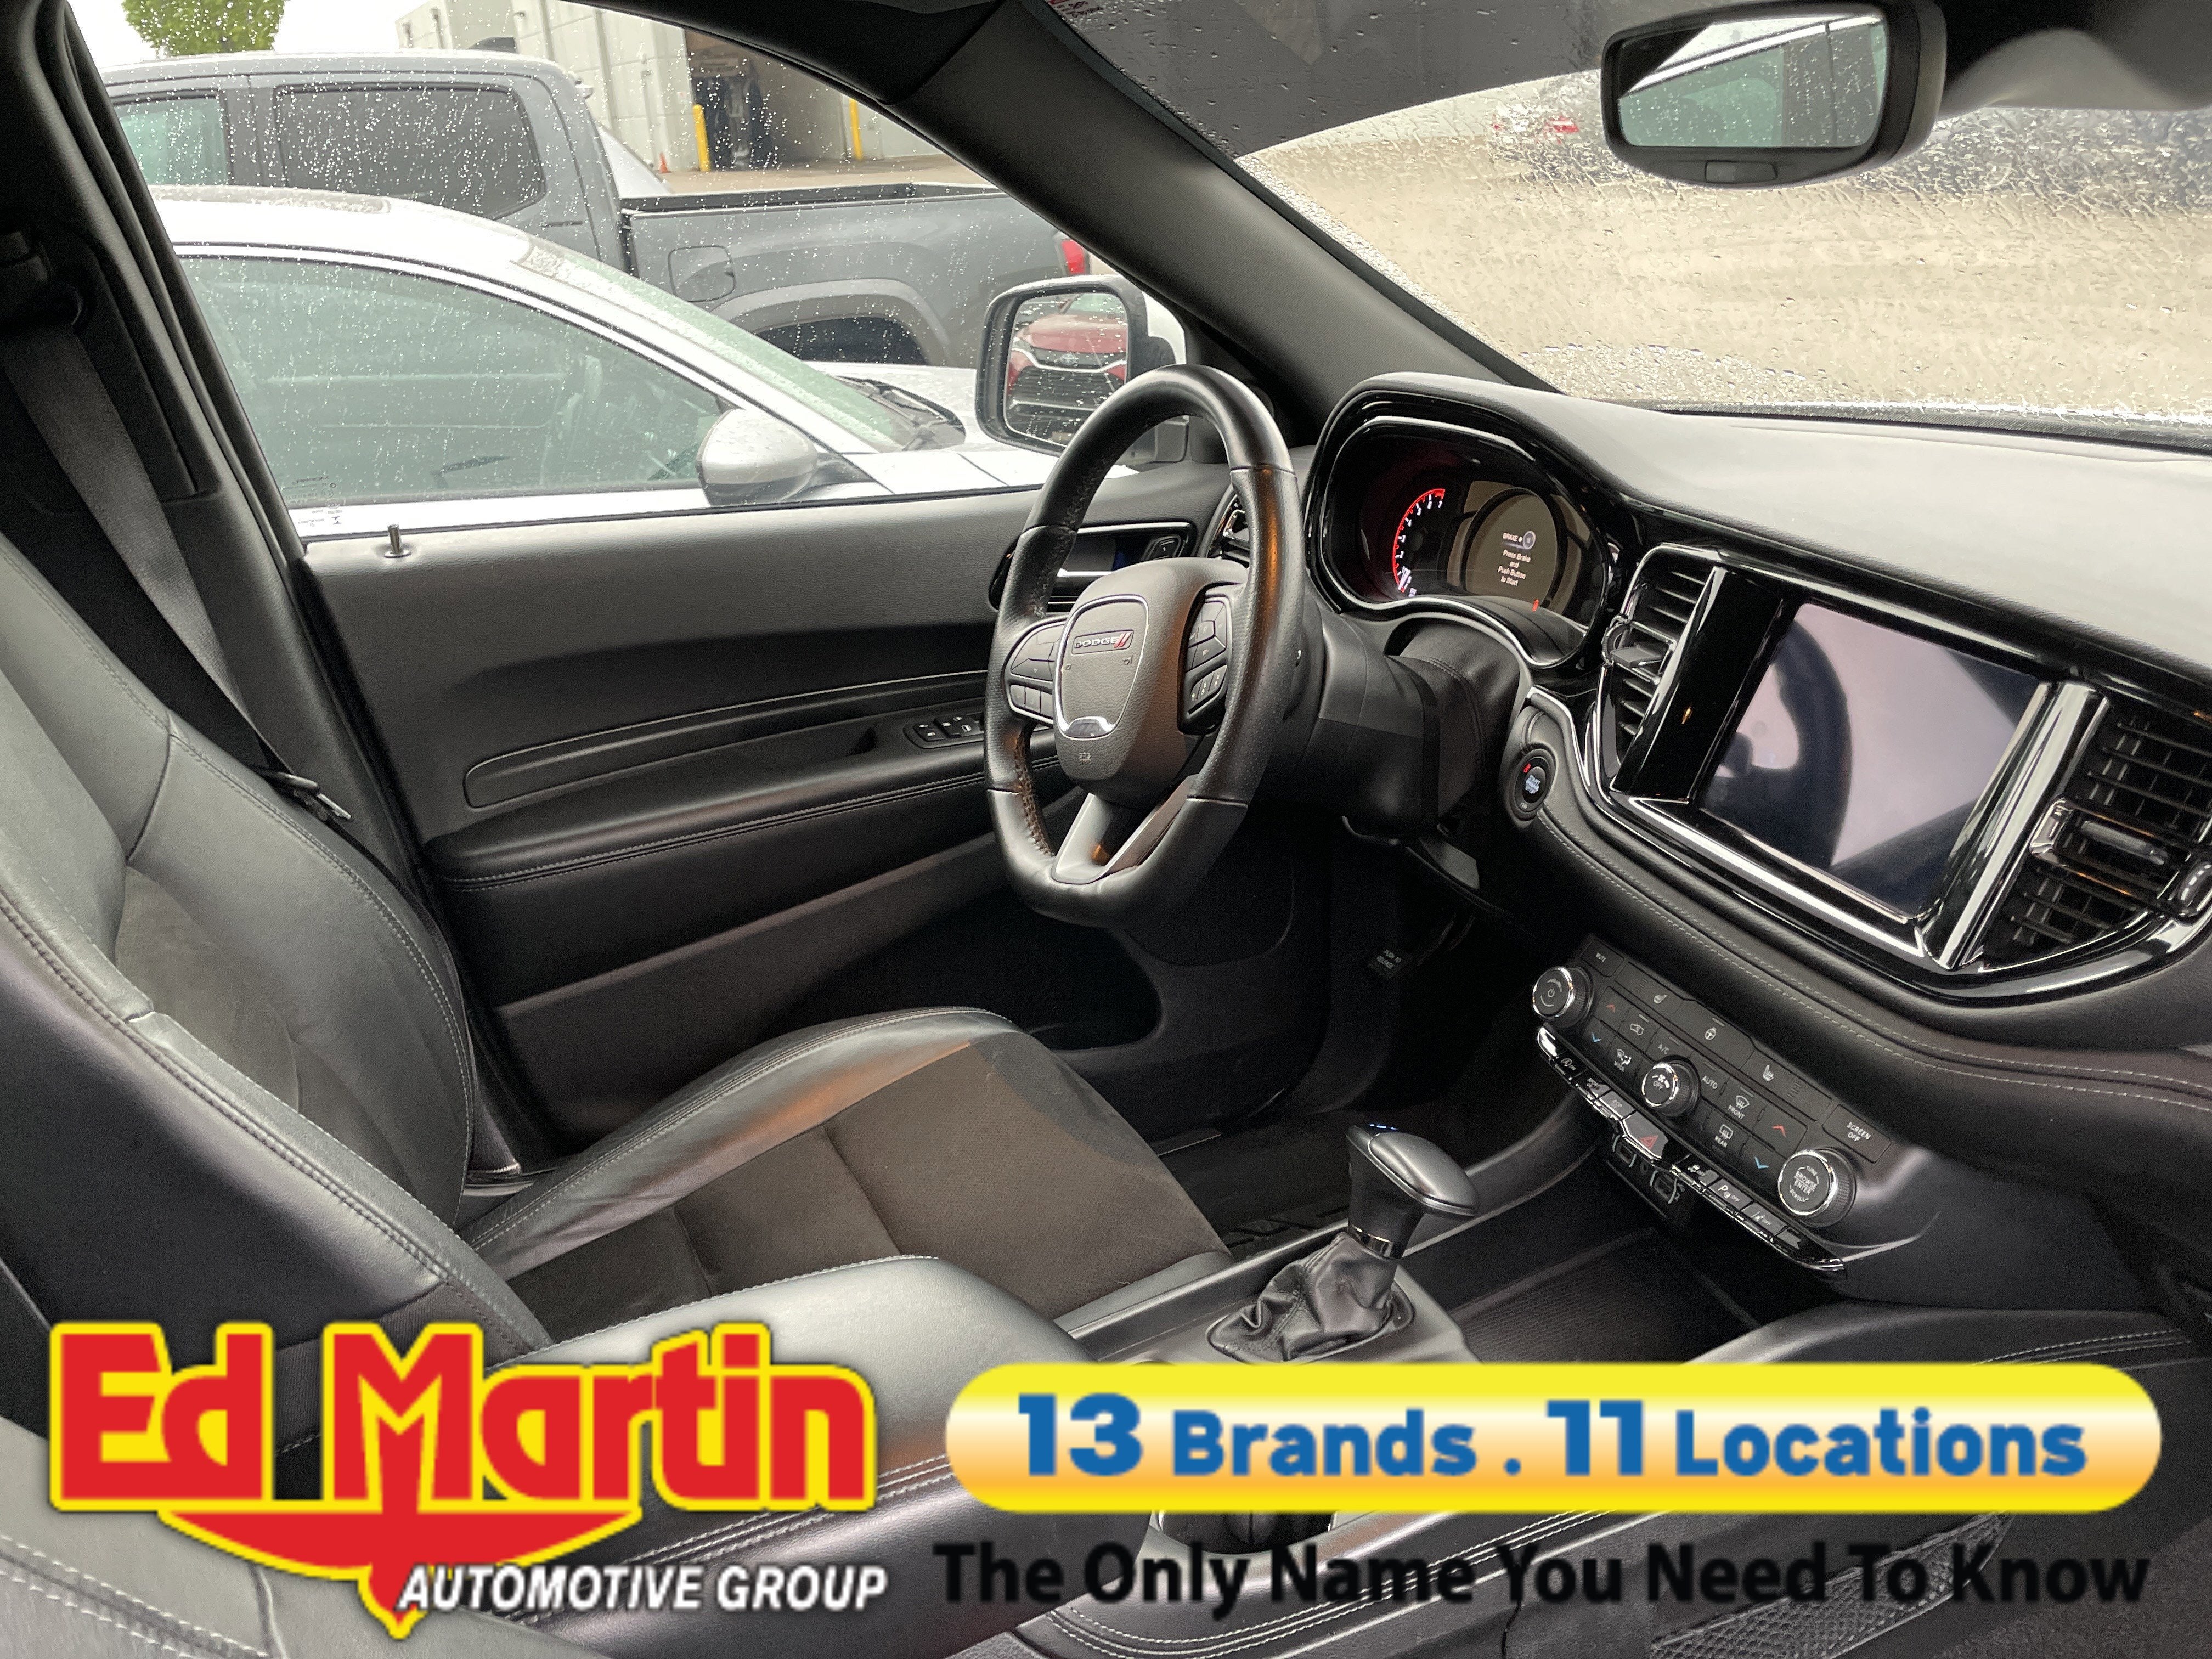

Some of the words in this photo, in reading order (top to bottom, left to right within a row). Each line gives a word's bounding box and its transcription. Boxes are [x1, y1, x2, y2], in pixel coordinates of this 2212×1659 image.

[1502, 549, 1516, 559] Press
[1516, 553, 1531, 563] Brake
[1497, 565, 1510, 575] Push
[1510, 569, 1526, 580] Button
[1506, 577, 1519, 586] Start
[1074, 636, 1120, 649] DODGE
[1658, 1043, 1669, 1055] A/C
[1701, 1075, 1718, 1090] AUTO
[1728, 1104, 1745, 1120] FRONT
[1847, 1121, 1871, 1140] SCREEN
[1847, 1131, 1861, 1142] OFF
[1714, 1135, 1728, 1149] REAR
[1795, 1170, 1818, 1189] BROWSE
[1793, 1180, 1811, 1195] ENTER
